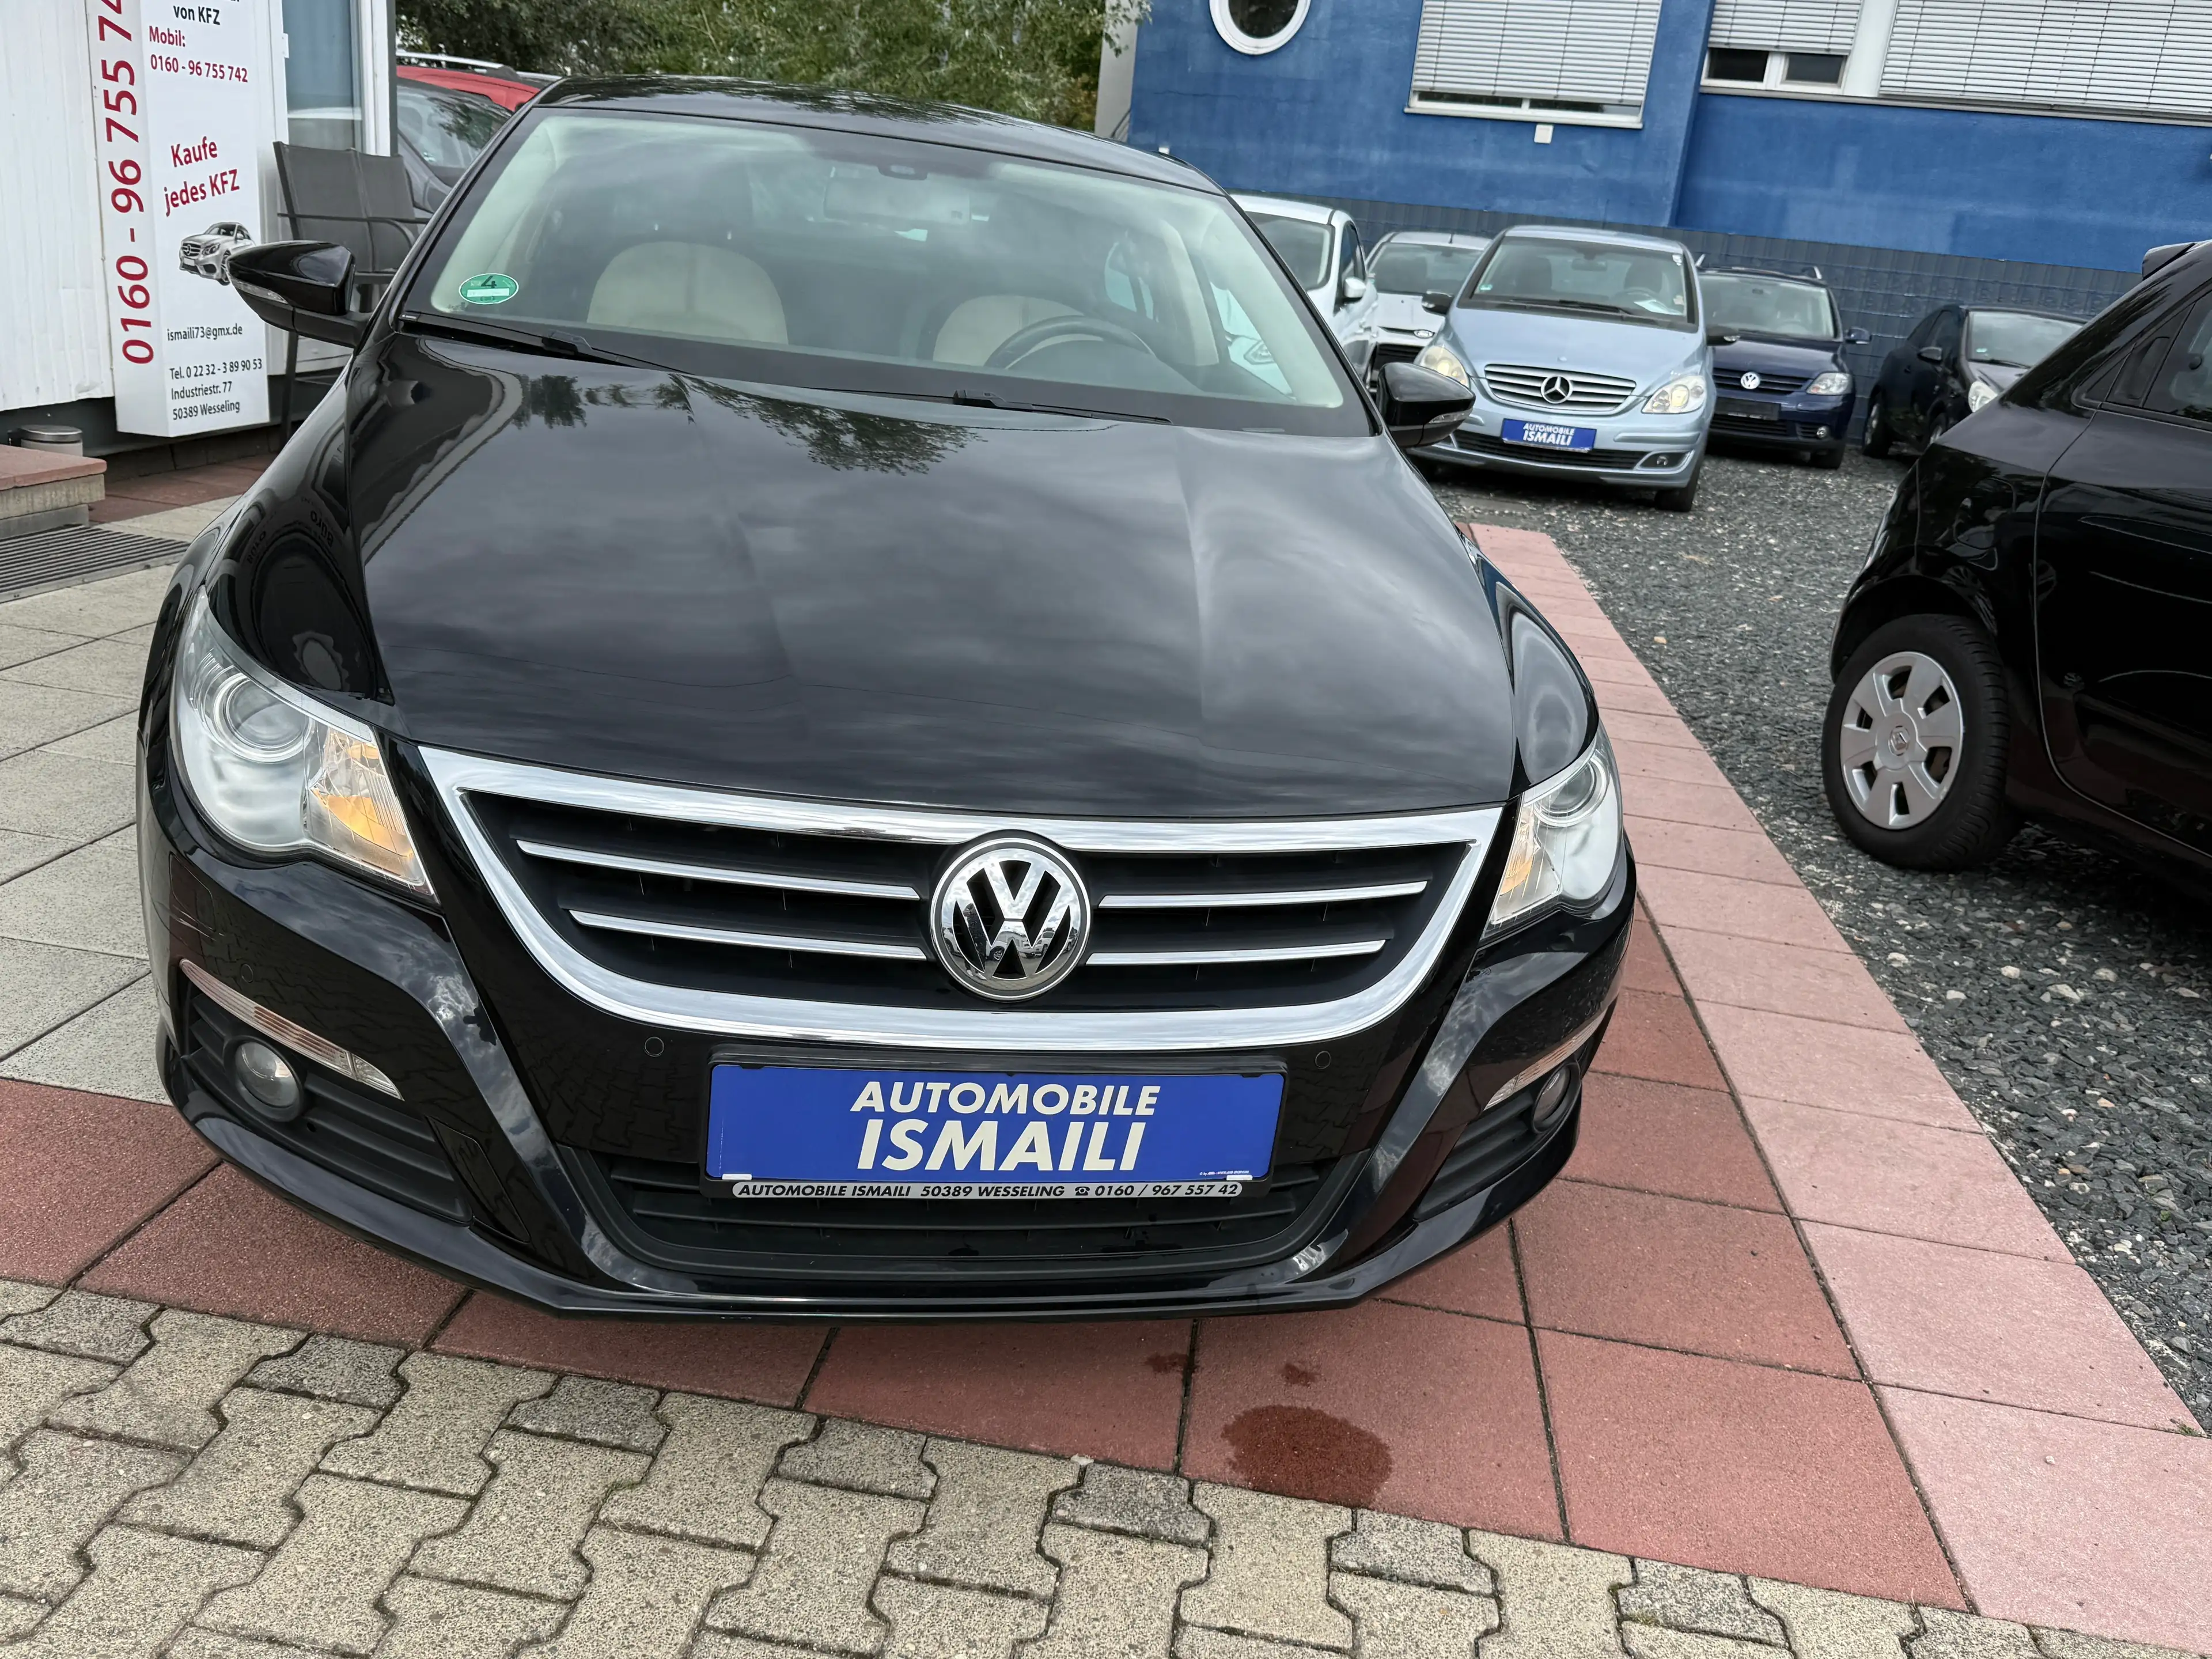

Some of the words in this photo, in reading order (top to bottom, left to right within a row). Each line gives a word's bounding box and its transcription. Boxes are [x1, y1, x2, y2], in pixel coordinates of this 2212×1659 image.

[173, 5, 195, 21] von
[198, 6, 221, 25] KFZ
[149, 25, 185, 47] Mobil:
[150, 54, 179, 73] 0160
[188, 60, 202, 76] 96
[204, 62, 225, 79] 755
[228, 66, 248, 83] 742
[101, 59, 139, 143] 755
[171, 136, 218, 168] Kaufe
[108, 160, 145, 213] 96
[164, 181, 207, 217] jedes
[209, 169, 240, 196] KFZ
[130, 228, 135, 242] -
[481, 275, 497, 289] 4
[116, 255, 154, 364] 0160
[167, 323, 243, 341] ismaili73@gmx.de
[169, 366, 185, 380] Tel.
[186, 366, 191, 378] 0
[194, 366, 203, 377] 22
[206, 364, 216, 376] 32
[222, 362, 228, 373] 3
[229, 361, 239, 372] 89
[241, 359, 251, 372] 90
[253, 358, 262, 370] 53
[171, 384, 221, 400] Industriestr.
[222, 381, 232, 393] 77
[173, 406, 198, 421] 50389
[199, 400, 240, 416] Wesseling
[1522, 422, 1575, 435] AUTOMOBILE
[1522, 430, 1573, 446] ISMAILI
[850, 1081, 1161, 1115] AUTOMOBILE
[857, 1119, 1146, 1171] ISMAILI
[738, 1184, 847, 1196] AUTOMOBILE
[851, 1185, 912, 1196] ISMAILI
[921, 1185, 972, 1197] 50389
[978, 1185, 1065, 1197] WESSELING
[1094, 1185, 1134, 1196] 0160
[1138, 1184, 1147, 1196] /
[1152, 1185, 1180, 1195] 967
[1185, 1184, 1213, 1195] 557
[1218, 1184, 1238, 1195] 42
